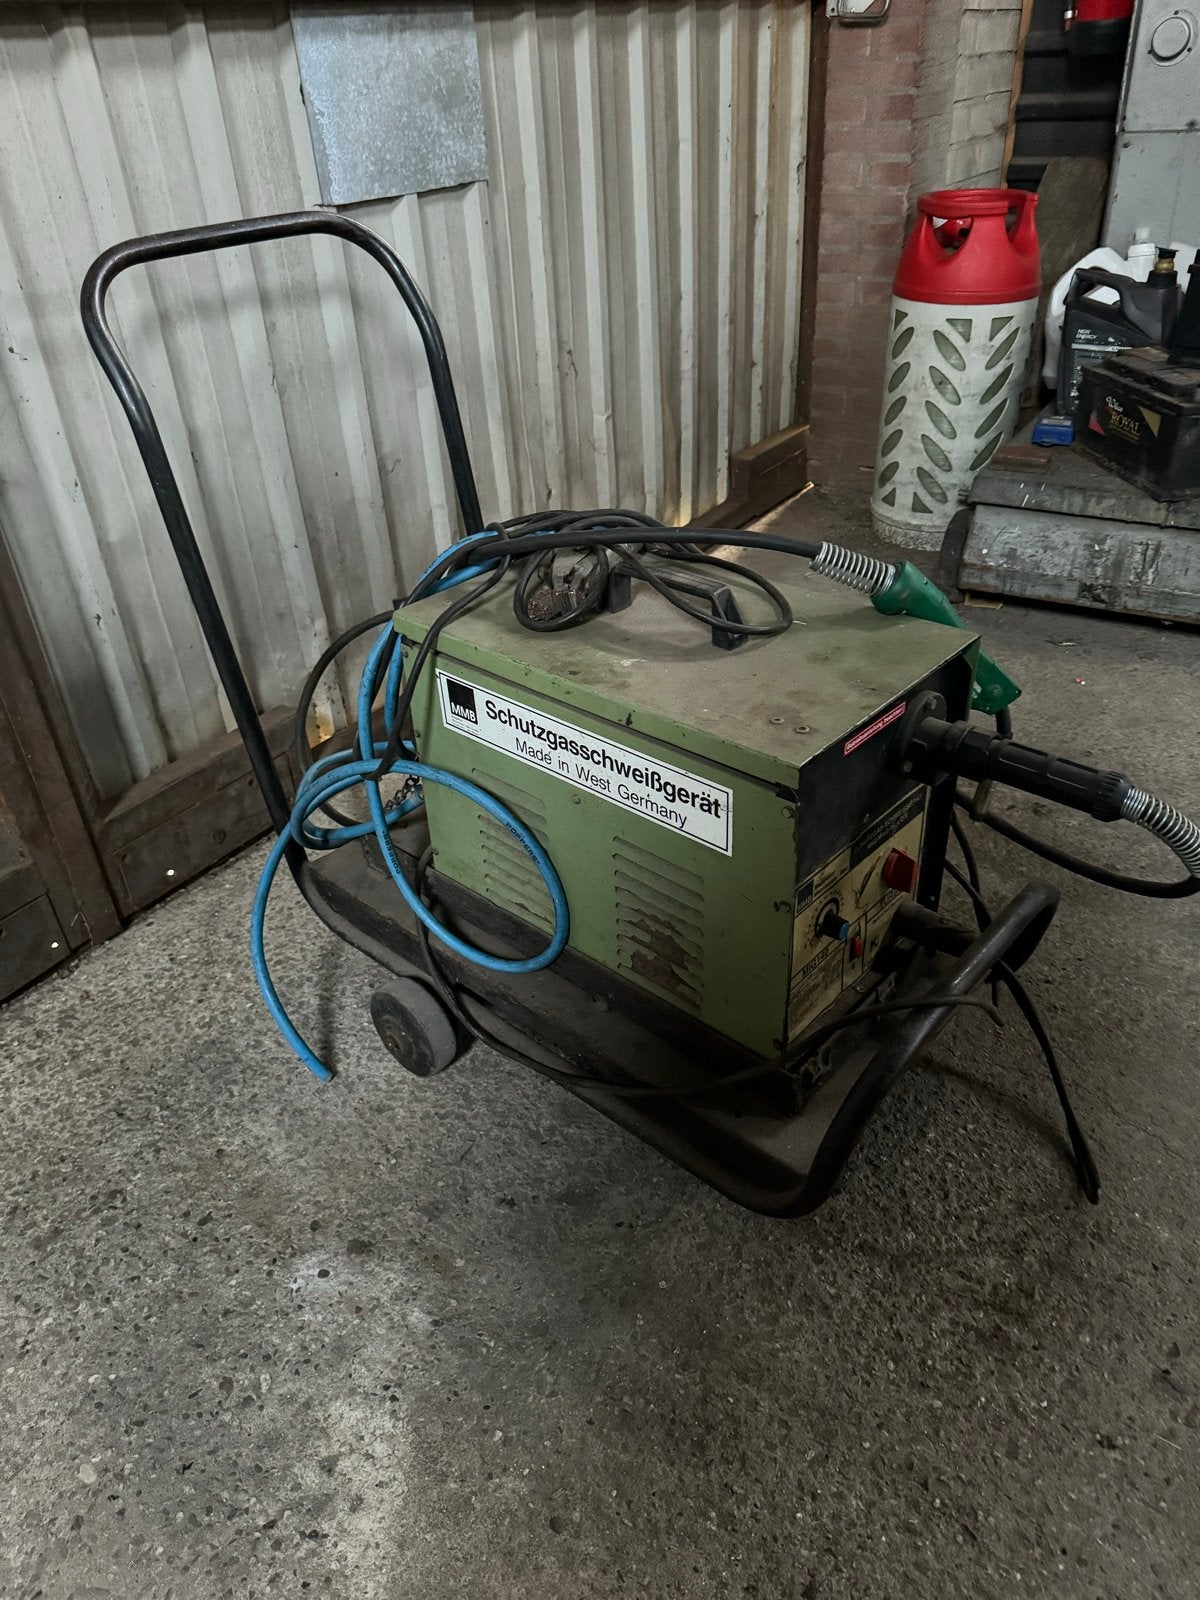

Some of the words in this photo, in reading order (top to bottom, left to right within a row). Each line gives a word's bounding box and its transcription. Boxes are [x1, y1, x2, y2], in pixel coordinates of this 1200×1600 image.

[1111, 411, 1141, 435] ROYAL
[450, 701, 476, 722] MMB
[485, 699, 721, 819] Schutzgasschweißgerät
[515, 737, 552, 765] Made
[558, 755, 570, 773] in
[575, 766, 612, 794] West
[618, 784, 688, 829] Germany
